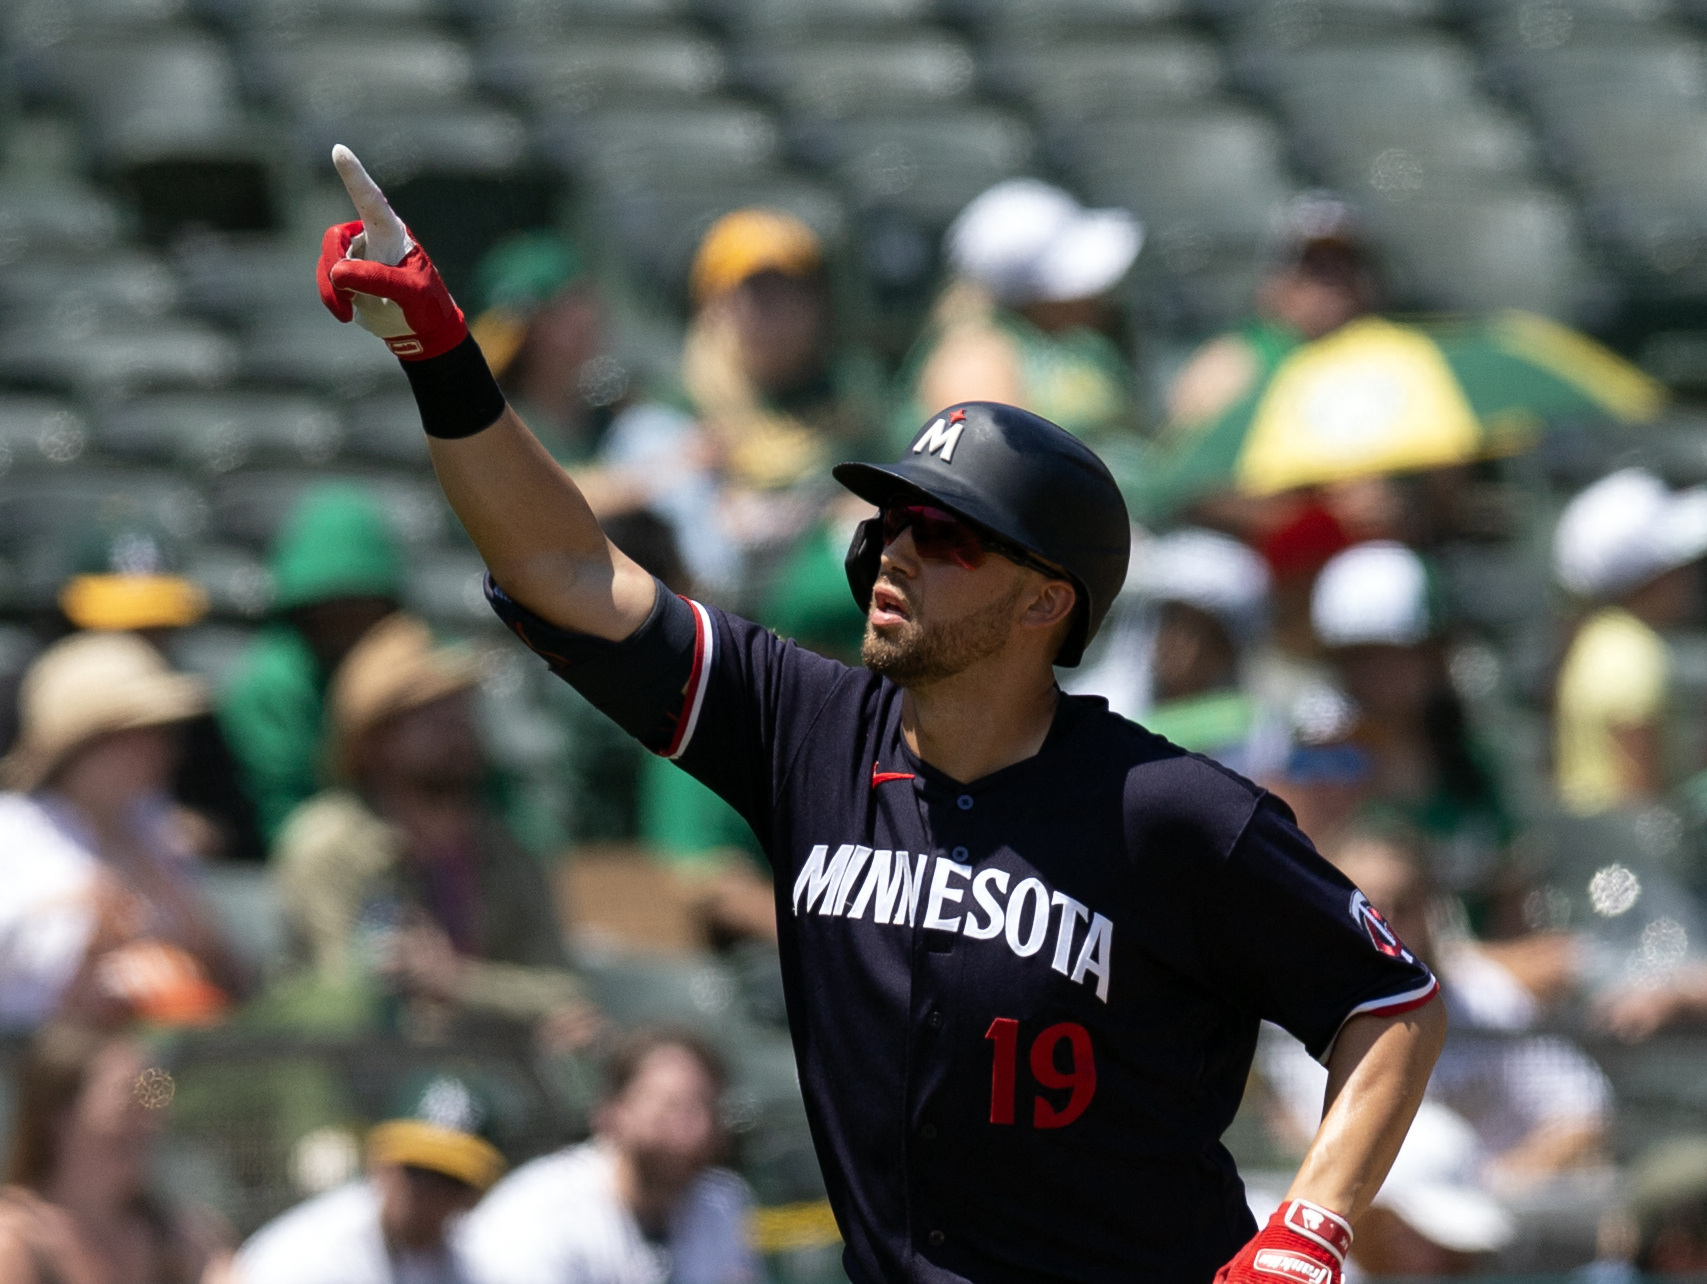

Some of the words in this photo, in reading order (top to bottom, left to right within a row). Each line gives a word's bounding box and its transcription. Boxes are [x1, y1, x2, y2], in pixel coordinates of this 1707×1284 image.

[912, 418, 964, 463] M
[793, 844, 1114, 1004] MINNESOTA
[985, 1017, 1097, 1129] 19
